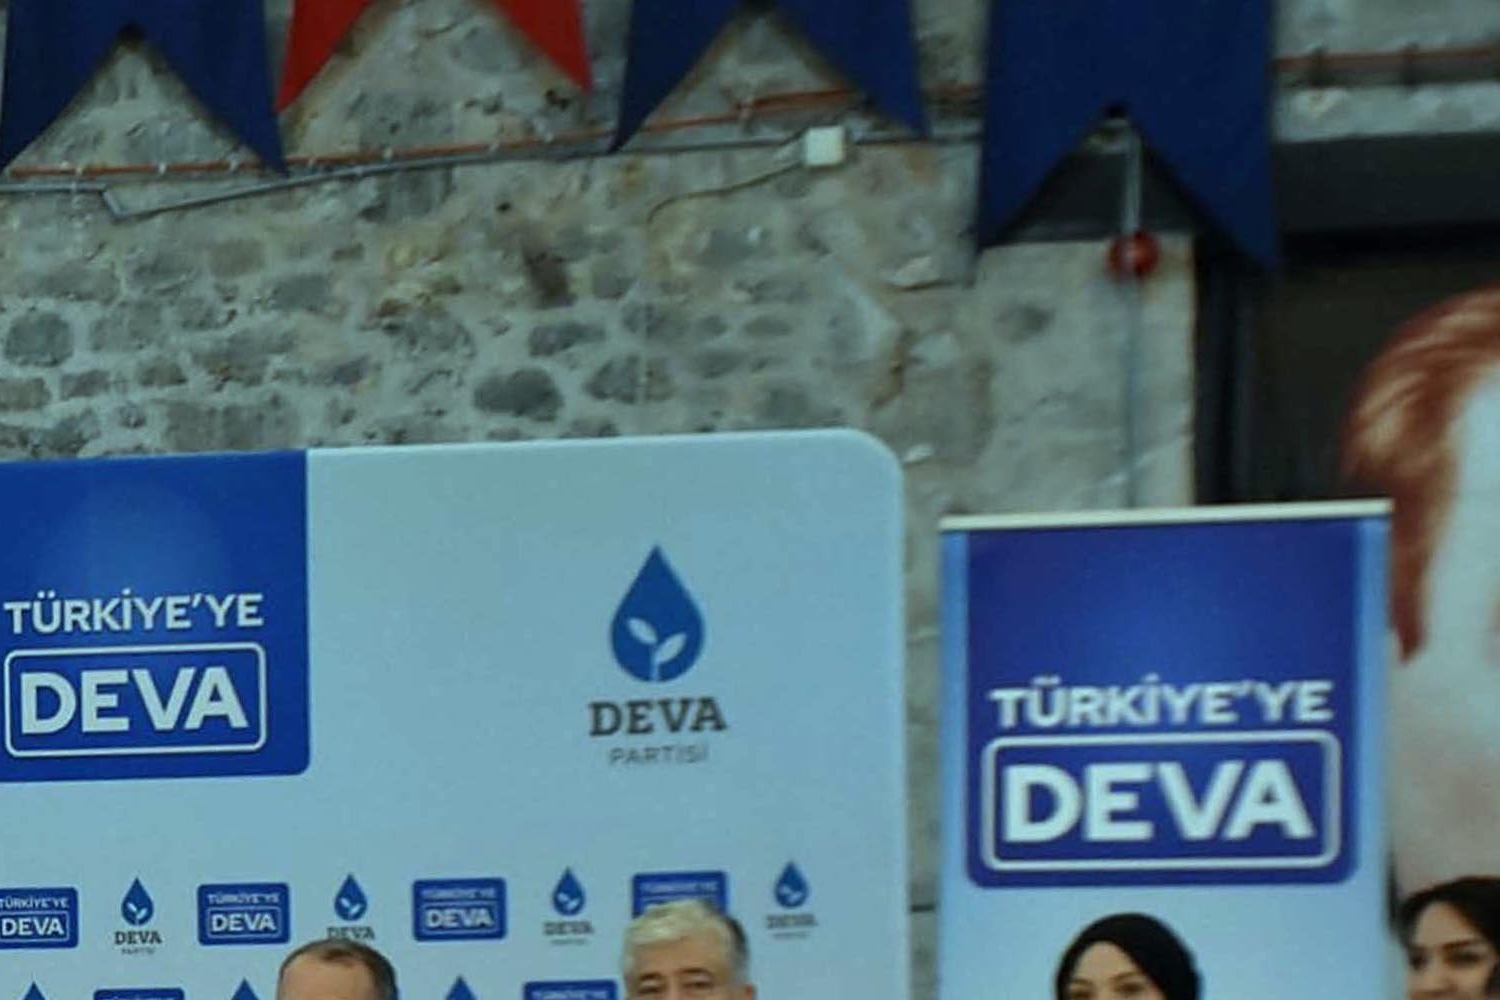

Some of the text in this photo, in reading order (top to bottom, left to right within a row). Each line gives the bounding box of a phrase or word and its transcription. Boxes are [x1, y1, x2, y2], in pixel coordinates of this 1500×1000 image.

[4, 588, 265, 635] TÜRKİYE'YE
[20, 667, 249, 734] DEVA
[588, 696, 729, 736] DEVA
[989, 674, 1334, 728] TÜRKİYE'YE
[1002, 759, 1315, 844] DEVA
[1, 918, 65, 937] DEVA
[114, 930, 162, 945] DEVA
[211, 912, 276, 933] DEVA
[426, 907, 495, 928] DEVA
